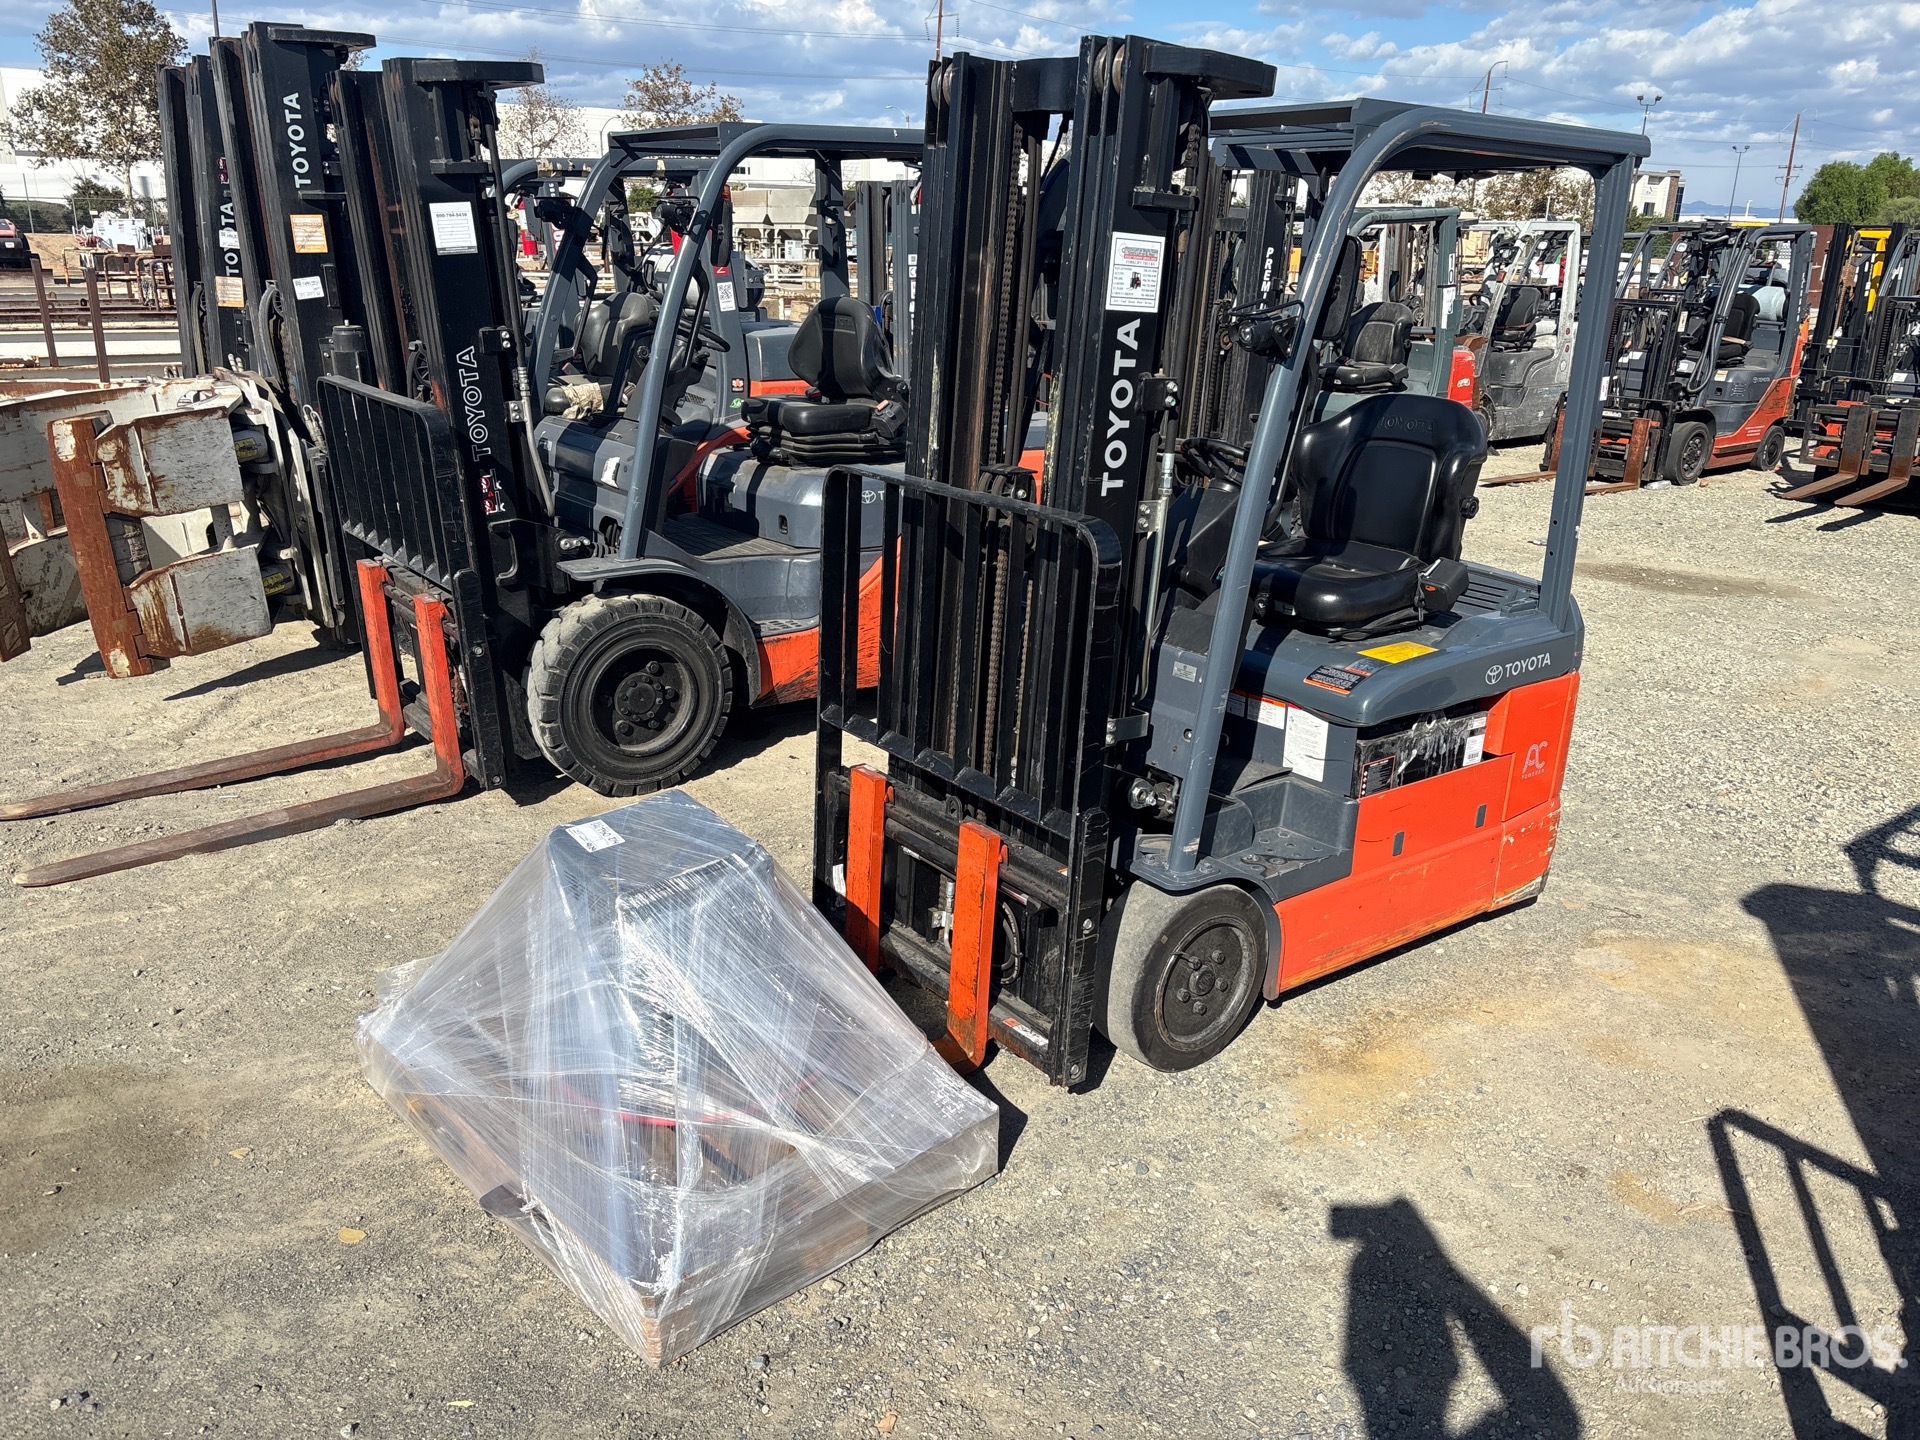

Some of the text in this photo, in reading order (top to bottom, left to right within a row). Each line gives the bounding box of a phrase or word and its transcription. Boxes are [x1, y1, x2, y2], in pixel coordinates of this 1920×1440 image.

[282, 92, 312, 189] TOYOTA
[219, 202, 240, 277] TOTA
[455, 345, 492, 462] TOYOTA
[1100, 317, 1141, 498] TOYOTA
[1505, 652, 1551, 678] TOYOTA
